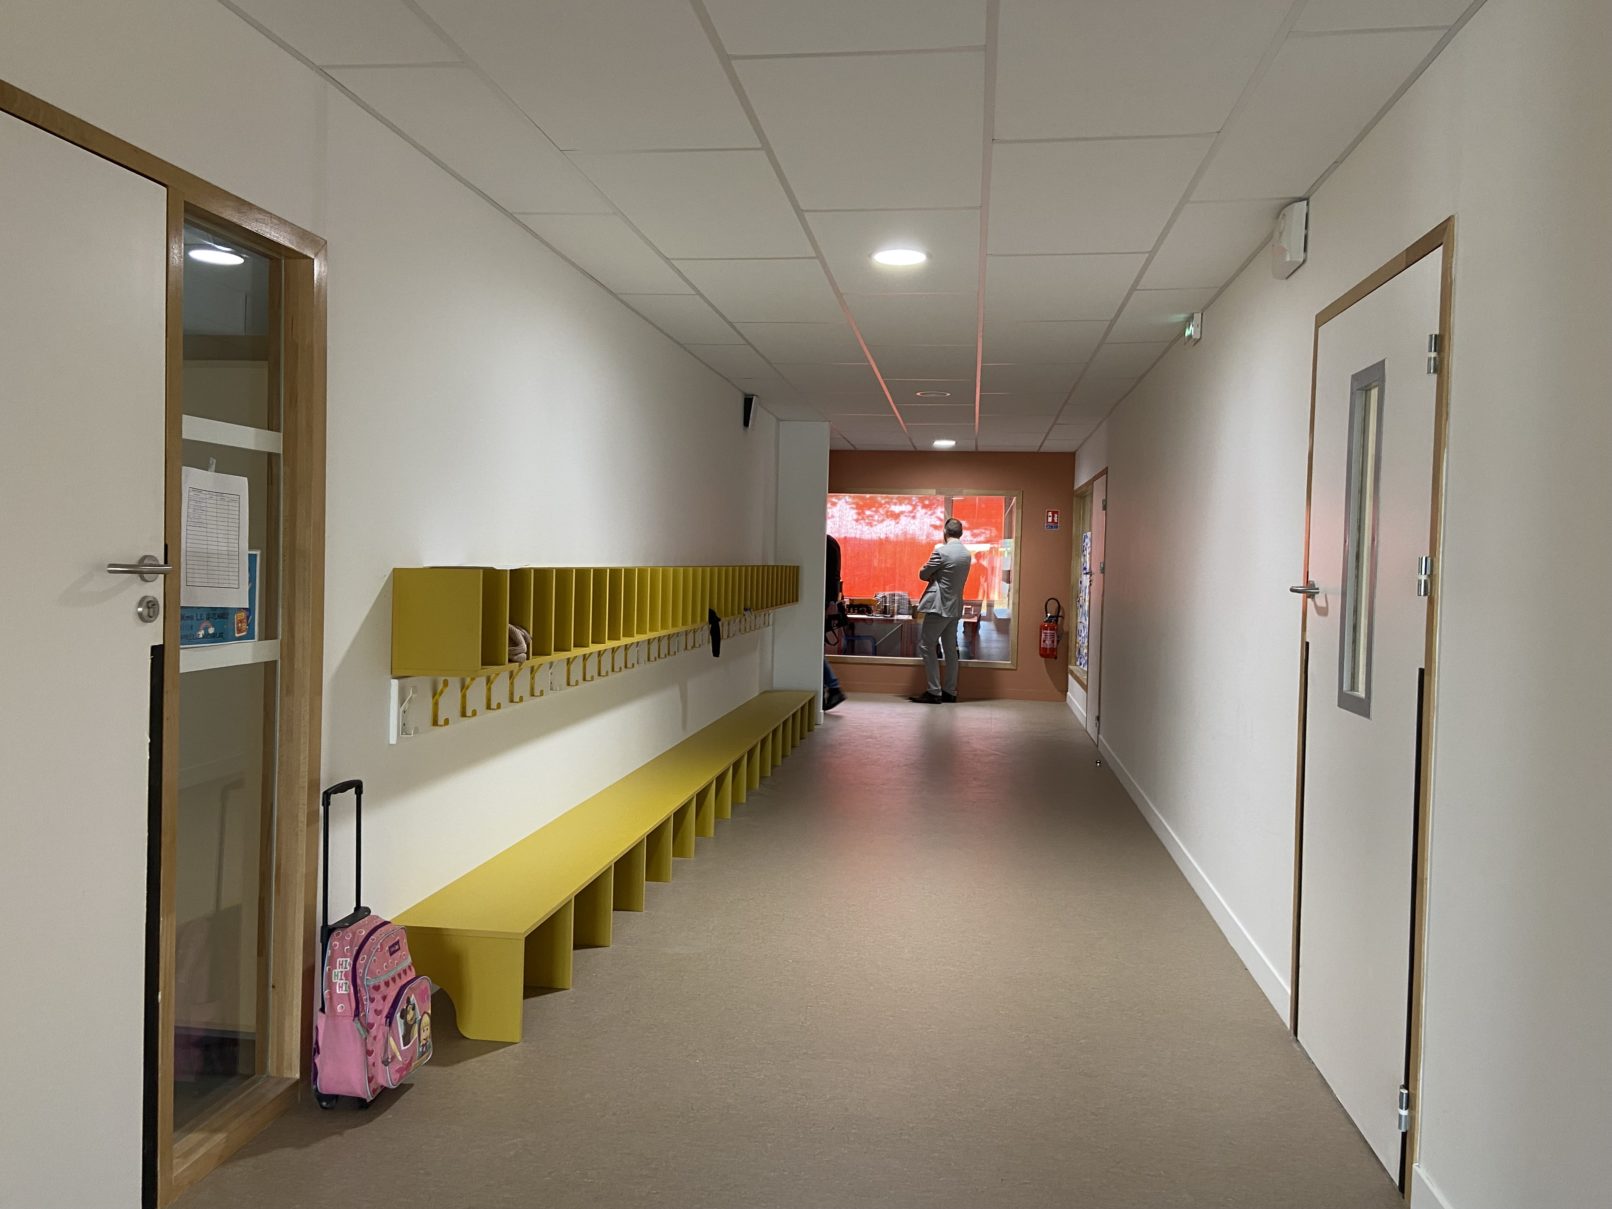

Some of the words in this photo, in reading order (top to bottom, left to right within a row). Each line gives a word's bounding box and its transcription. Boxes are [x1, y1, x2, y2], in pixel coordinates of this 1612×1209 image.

[337, 959, 349, 970] HI
[333, 969, 344, 981] HI
[337, 981, 349, 993] HI
